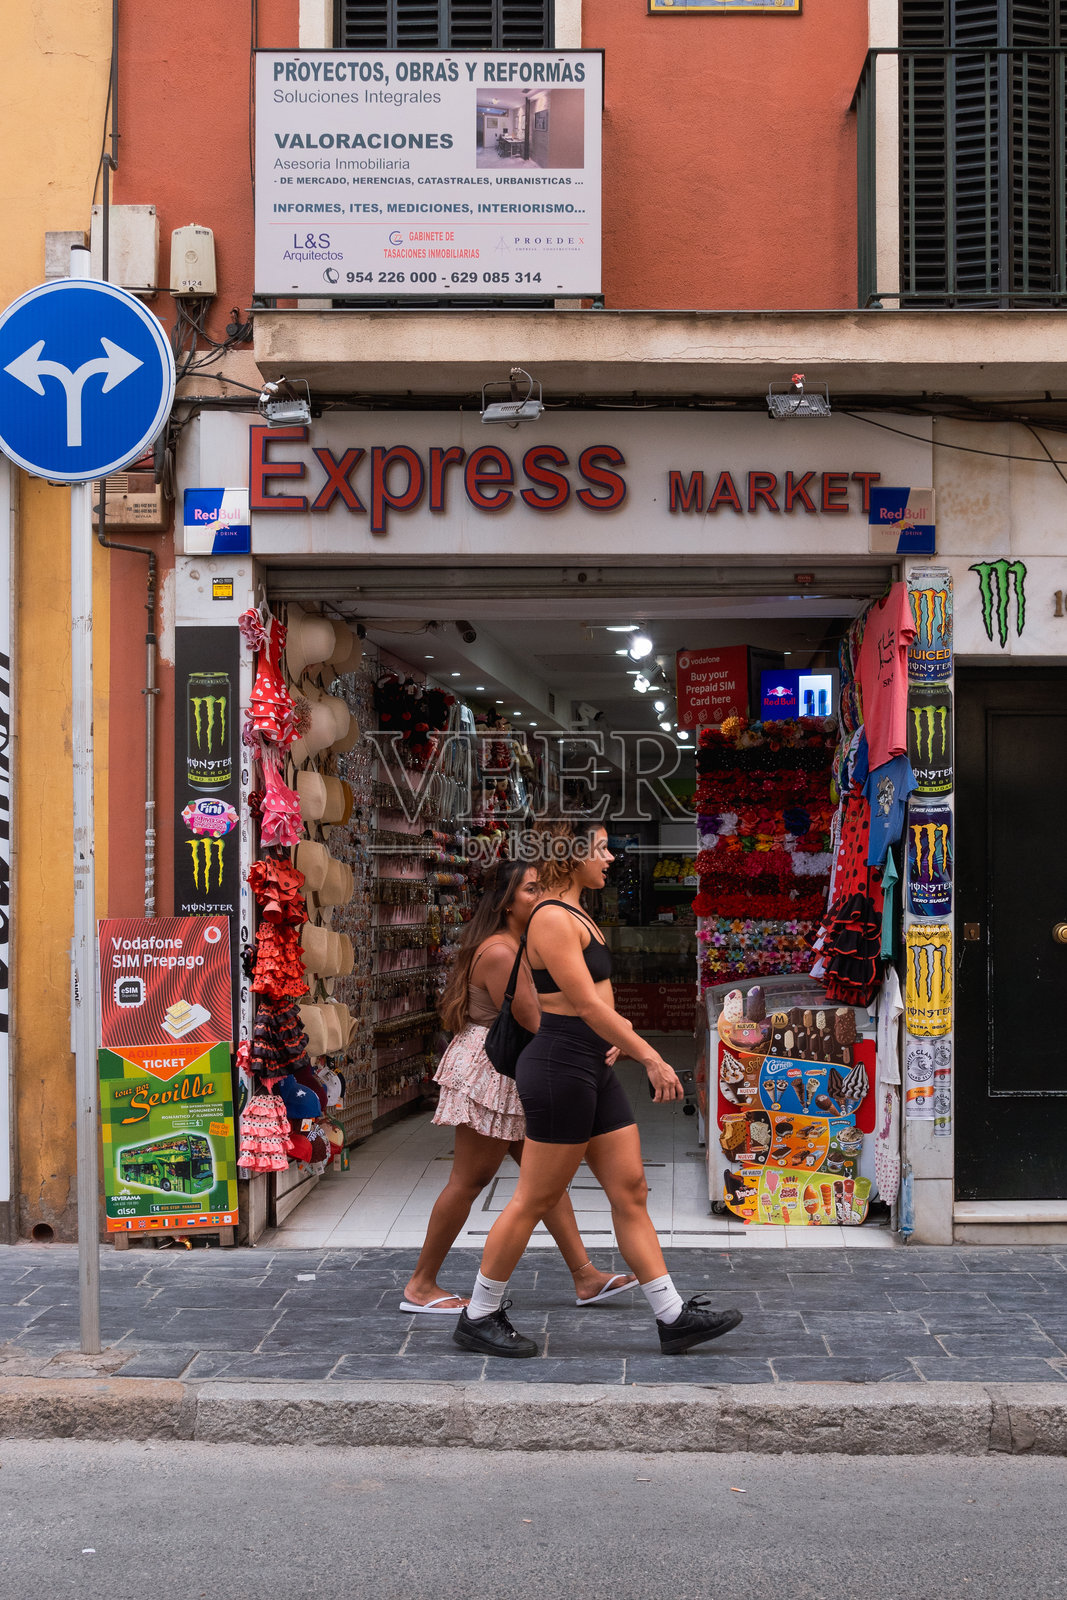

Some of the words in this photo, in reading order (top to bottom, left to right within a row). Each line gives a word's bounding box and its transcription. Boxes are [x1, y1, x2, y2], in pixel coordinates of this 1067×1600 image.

[273, 62, 390, 86] PROYECTOS,
[396, 62, 459, 82] OBRAS
[468, 62, 478, 82] Y
[484, 62, 586, 82] REFORMAS
[273, 90, 359, 103] Soluciones
[365, 90, 441, 107] Integrales
[275, 133, 454, 149] VALORACIONES
[273, 158, 331, 170] Asesoria
[335, 158, 410, 170] Inmobiliaria
[280, 177, 294, 185] DE
[296, 177, 350, 186] MERCADO,
[353, 177, 414, 186] HERENCIAS,
[417, 177, 493, 186] CATASTRALES,
[496, 177, 572, 186] URBANISTICAS
[273, 203, 346, 215] INFORMES,
[350, 203, 383, 215] ITES,
[387, 203, 474, 215] MEDICIONES,
[477, 203, 586, 214] INTERIORISMO...
[293, 233, 331, 249] L&S
[409, 231, 439, 242] GABINETE
[442, 231, 455, 242] DE
[514, 237, 585, 245] PROEDEX
[283, 250, 344, 262] Arquitectos
[384, 248, 427, 259] TASACIONES
[429, 248, 480, 259] INMOBILIARIAS
[346, 272, 374, 283] 954
[378, 272, 405, 283] 226
[410, 272, 437, 283] 000
[451, 272, 478, 283] 629
[483, 272, 510, 283] 085
[514, 272, 542, 283] 314
[249, 424, 627, 534] Express
[668, 471, 881, 513] MARKET
[194, 509, 217, 520] Red
[218, 508, 241, 519] Bull
[879, 507, 902, 519] Red
[904, 508, 926, 520] Bull
[690, 655, 720, 665] vodafone
[908, 648, 951, 661] JUICED
[691, 672, 708, 683] Buy
[709, 670, 729, 682] your
[685, 683, 718, 695] Prepaid
[719, 681, 736, 691] SIM
[690, 696, 710, 707] Card
[711, 695, 731, 705] here
[781, 697, 796, 706] Bull
[912, 767, 953, 780] ONSTER
[200, 803, 222, 815] Fini
[181, 902, 234, 913] MONSTER
[111, 936, 183, 950] Vodafone
[112, 954, 140, 968] SIM
[143, 954, 205, 970] Prepago
[142, 1058, 186, 1069] TICKET
[121, 1076, 215, 1124] Sevilla
